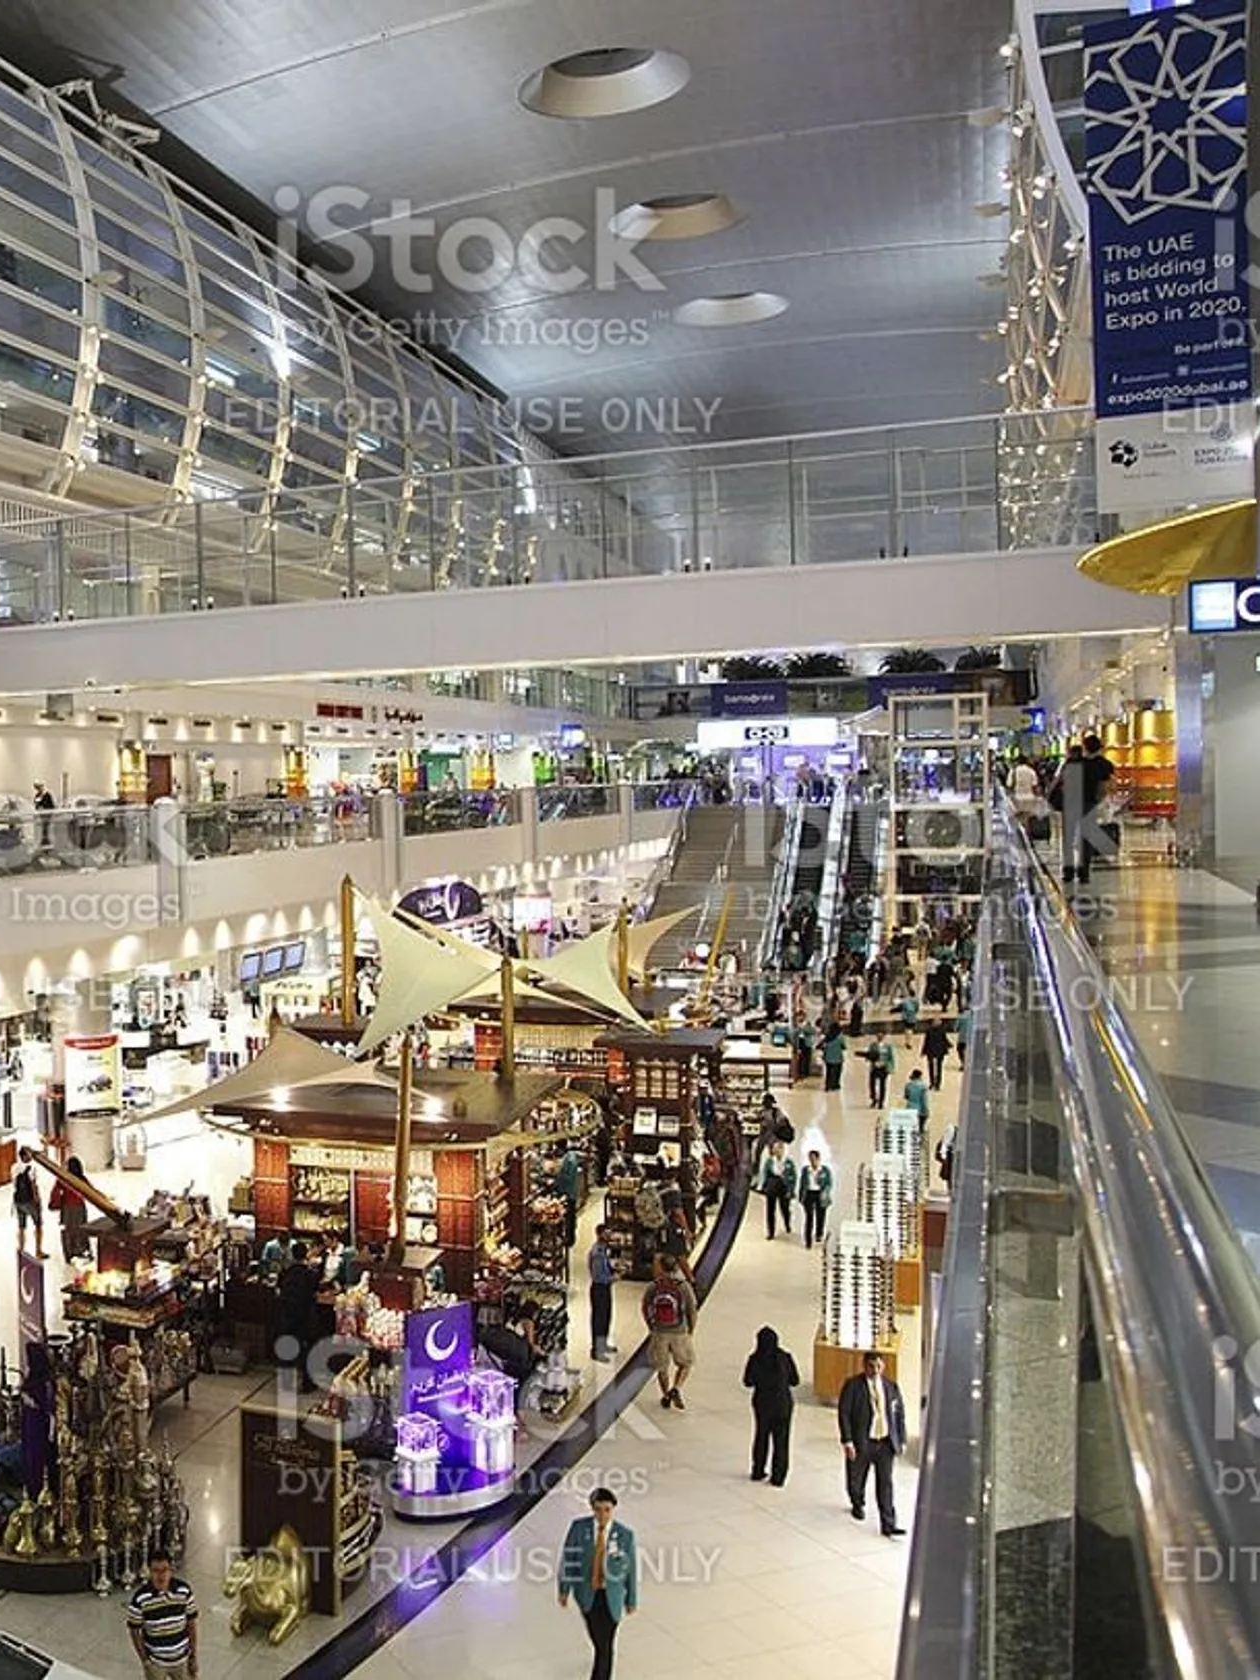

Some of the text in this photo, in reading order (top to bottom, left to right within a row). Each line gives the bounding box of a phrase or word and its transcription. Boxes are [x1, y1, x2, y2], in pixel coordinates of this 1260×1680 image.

[1102, 232, 1195, 262] The UAE
[1103, 253, 1235, 285] is bidding to
[1105, 277, 1219, 308] host World
[1105, 296, 1248, 331] Expo in 2020.
[1108, 379, 1249, 405] expo2020dubai.ae
